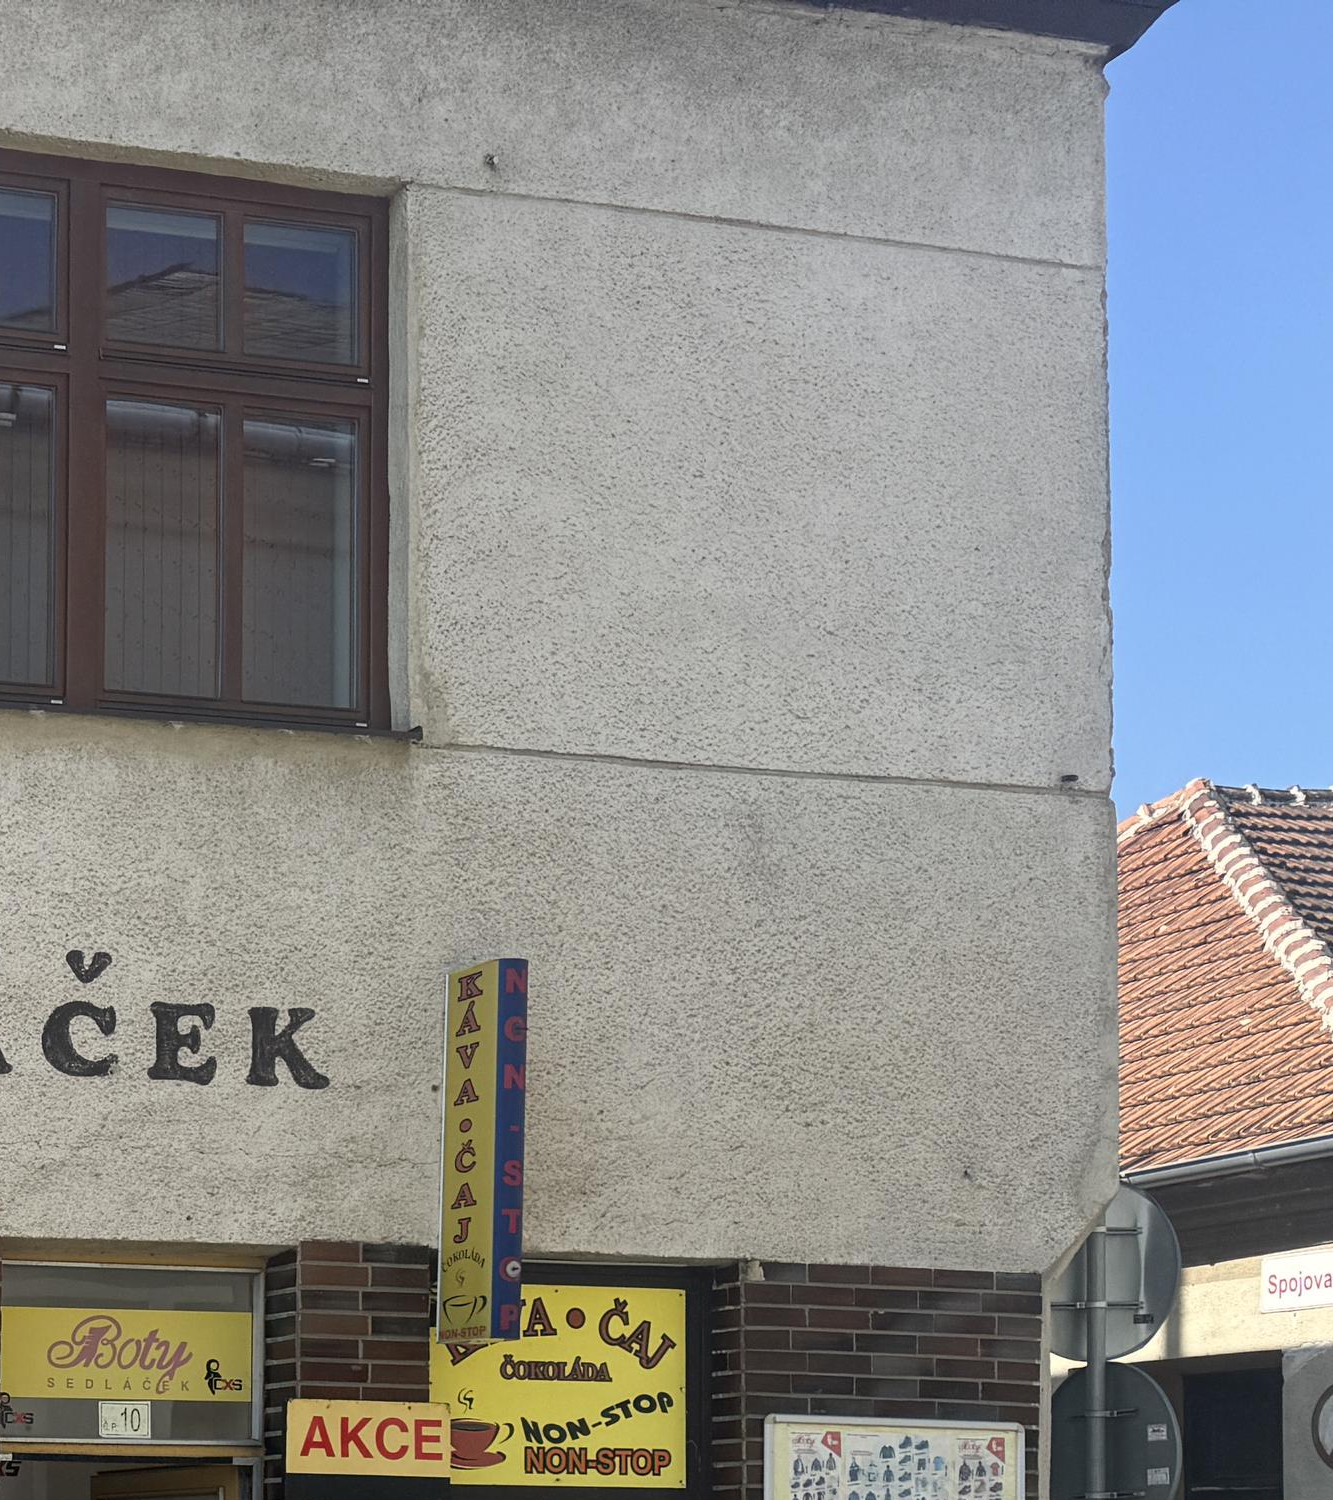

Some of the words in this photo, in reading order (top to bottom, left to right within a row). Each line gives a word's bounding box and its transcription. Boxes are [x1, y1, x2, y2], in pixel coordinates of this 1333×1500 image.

[454, 970, 483, 1106] KÁVA
[450, 1139, 477, 1244] ČAJ
[47, 1315, 193, 1395] Boty
[599, 1297, 676, 1370] ČAJ
[47, 1377, 190, 1391] SEDLÁČEK
[214, 1379, 243, 1391] CXS
[499, 1354, 613, 1383] ČOKOLÁDA
[120, 1407, 141, 1433] 10
[300, 1415, 444, 1461] AKCE
[520, 1391, 674, 1445] NON-STOP
[525, 1446, 672, 1476] NON-STOP
